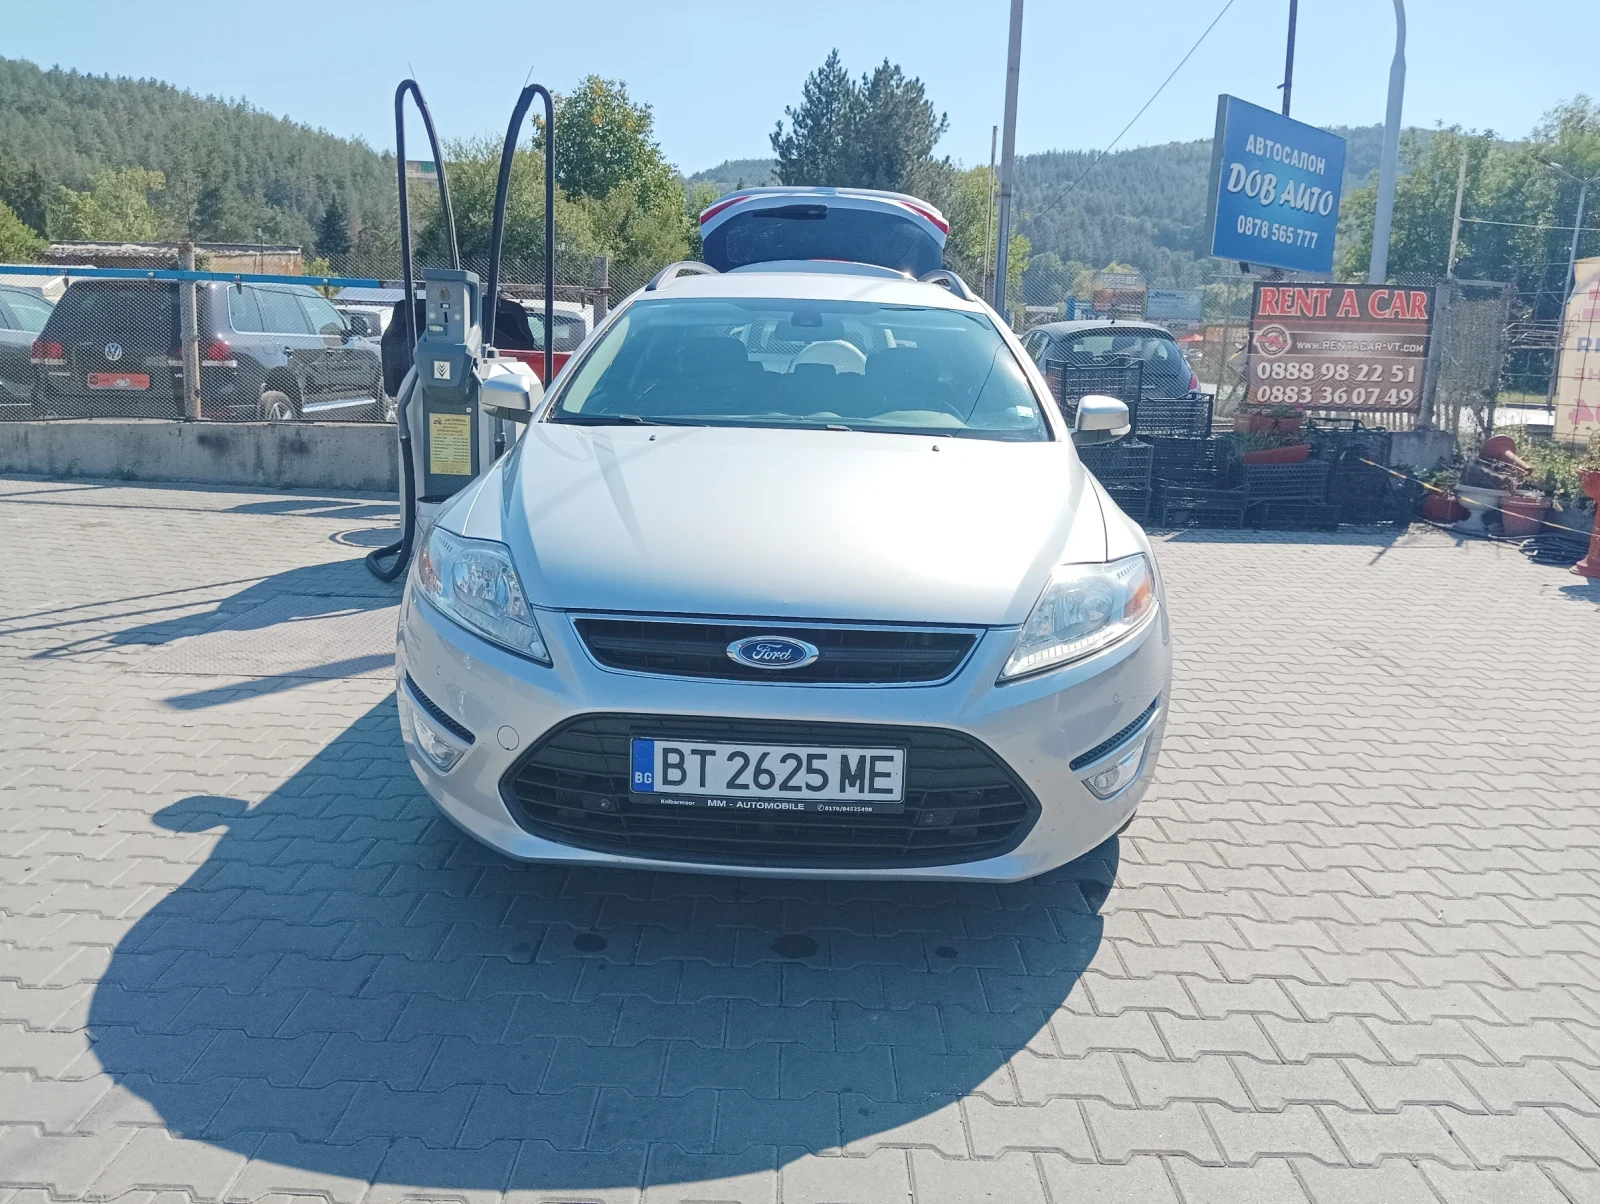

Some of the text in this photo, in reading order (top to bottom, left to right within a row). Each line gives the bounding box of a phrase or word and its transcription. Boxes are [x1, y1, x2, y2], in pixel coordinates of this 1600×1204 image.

[1246, 134, 1325, 175] АВТОСАЛОН
[1227, 162, 1333, 216] DOB AUTO
[1237, 215, 1319, 249] 0878 565 777
[1258, 287, 1428, 319] RENT A CAR
[1256, 362, 1415, 383] 0888 98 22 51
[1257, 386, 1414, 406] 0883 36 07 49
[752, 643, 793, 661] Ford
[634, 772, 652, 784] BG
[662, 748, 894, 794] BT 2625 ME
[707, 799, 726, 807] MM
[736, 801, 805, 810] AUTOMOBILE
